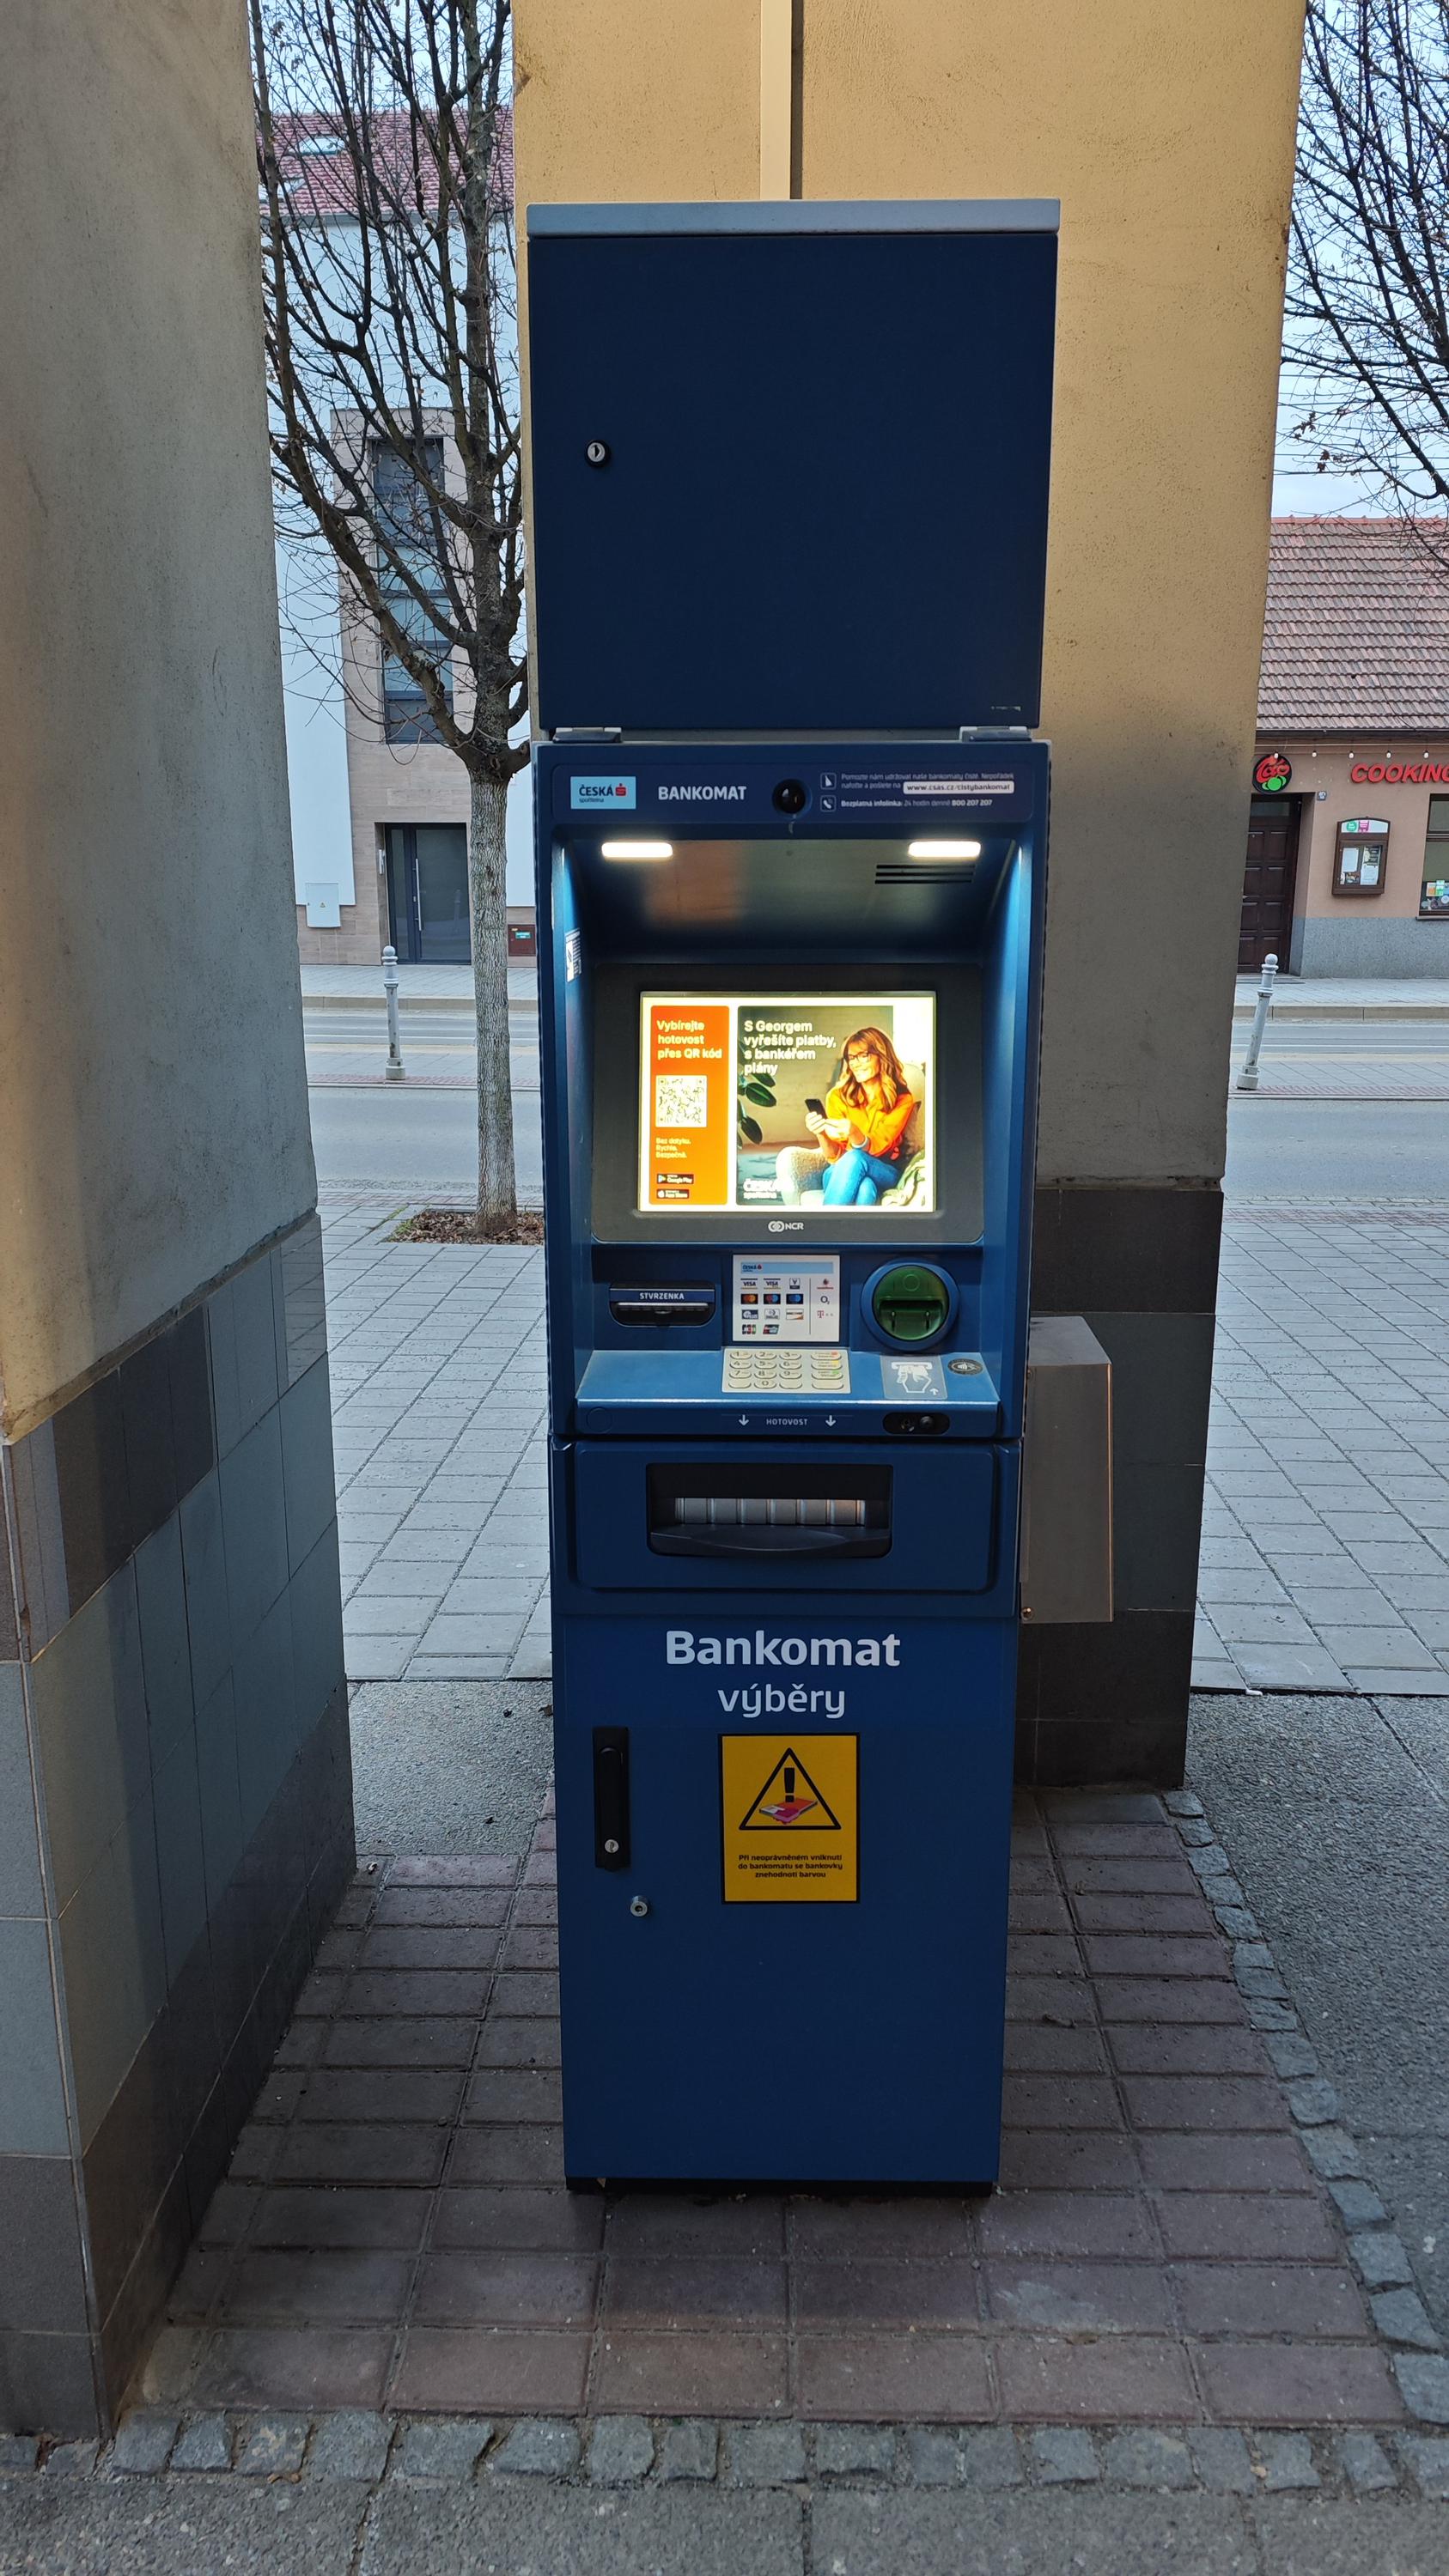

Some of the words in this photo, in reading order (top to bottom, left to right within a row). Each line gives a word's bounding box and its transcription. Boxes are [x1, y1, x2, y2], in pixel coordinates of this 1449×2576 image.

[579, 784, 613, 797] ČESKÁ
[658, 786, 747, 800] BANKOMAT
[656, 1020, 705, 1032] Vybírejte
[744, 1020, 753, 1032] S
[756, 1020, 813, 1035] Georgem
[658, 1035, 704, 1044] hotovost
[744, 1034, 794, 1048] vyřešíte
[795, 1035, 837, 1048] platby,
[658, 1048, 682, 1060] přes
[684, 1048, 700, 1059] QR
[703, 1048, 722, 1058] kód
[744, 1049, 752, 1060] s
[755, 1048, 816, 1060] bankéřem
[744, 1061, 778, 1076] plány
[785, 1222, 804, 1230] NCR
[666, 1630, 901, 1667] Bankomat
[717, 1683, 845, 1719] výběry
